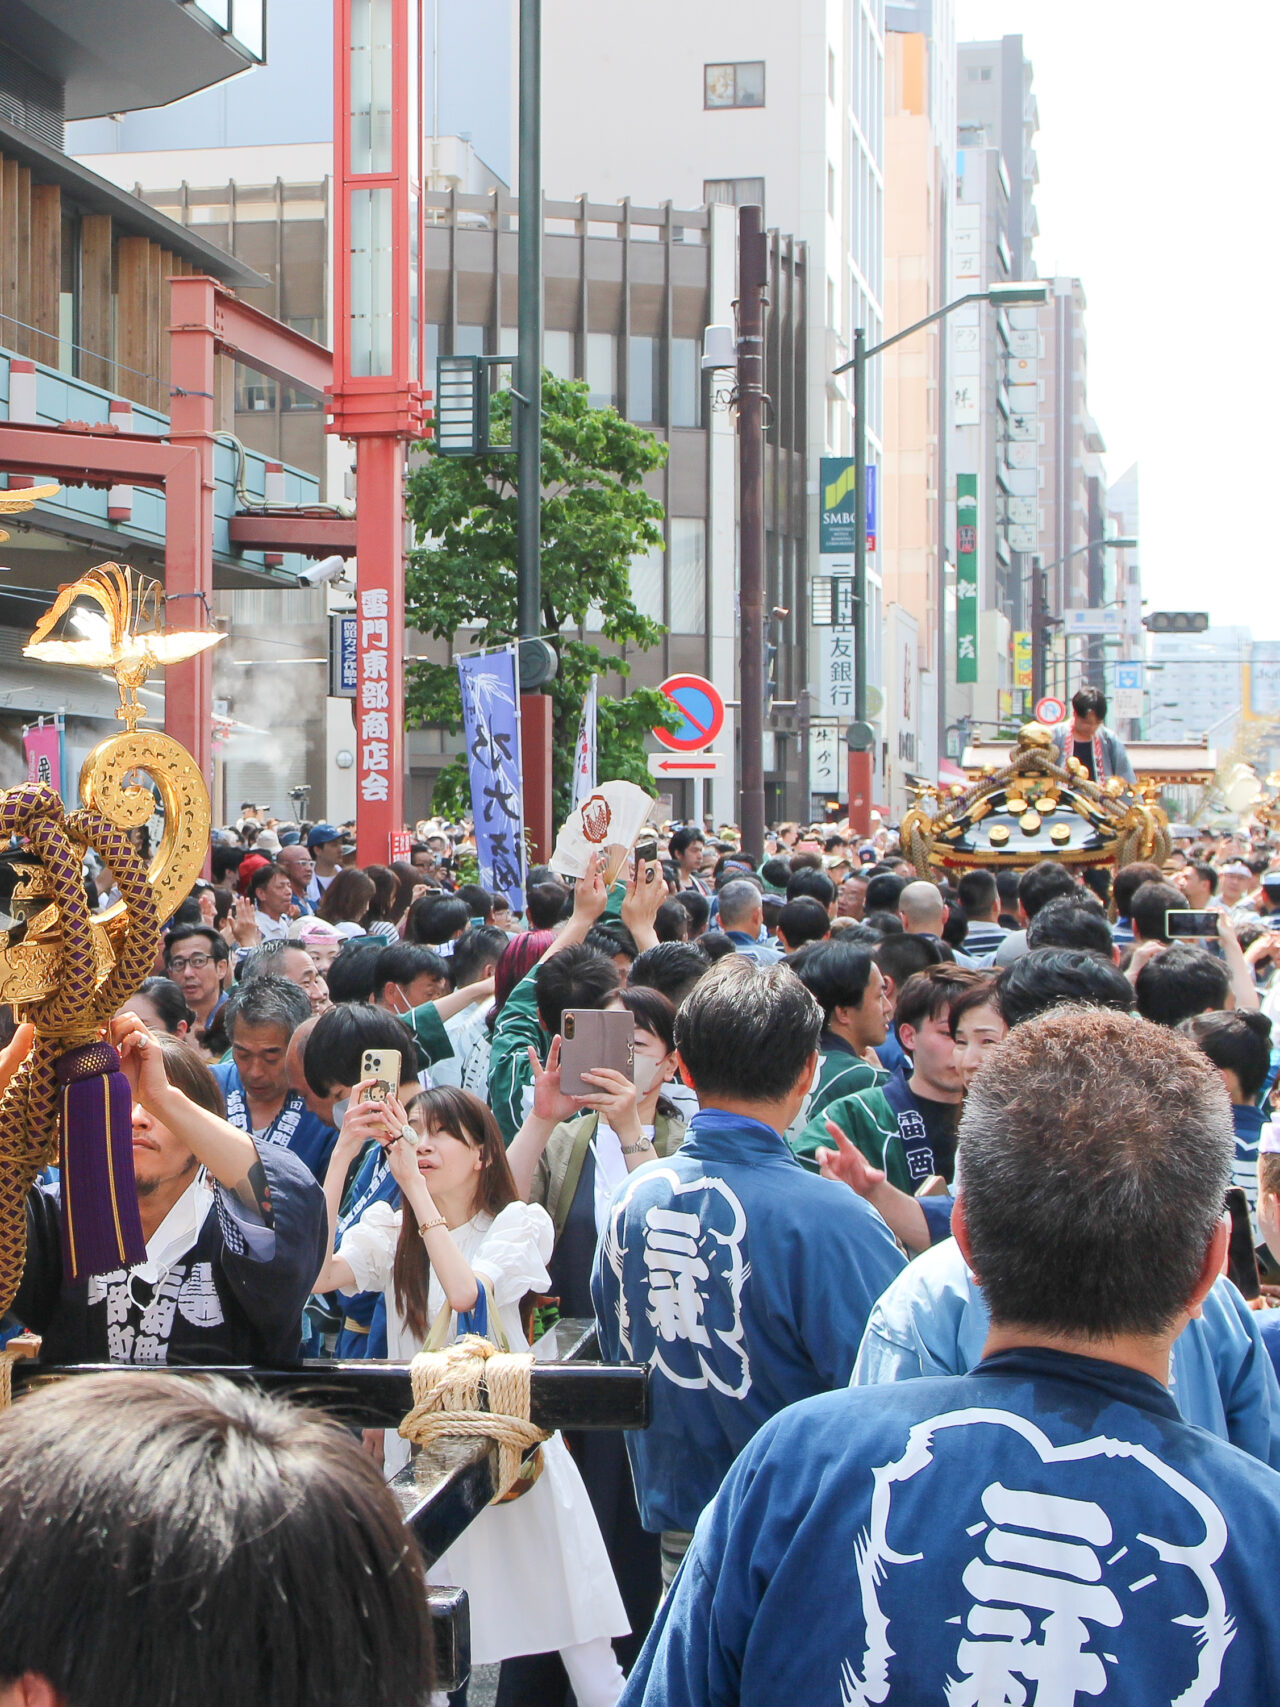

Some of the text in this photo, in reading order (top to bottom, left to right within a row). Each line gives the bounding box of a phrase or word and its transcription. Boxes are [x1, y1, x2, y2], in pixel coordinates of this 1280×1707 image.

[361, 588, 389, 802] 雷門東部商店会
[897, 1111, 935, 1180] 雷西
